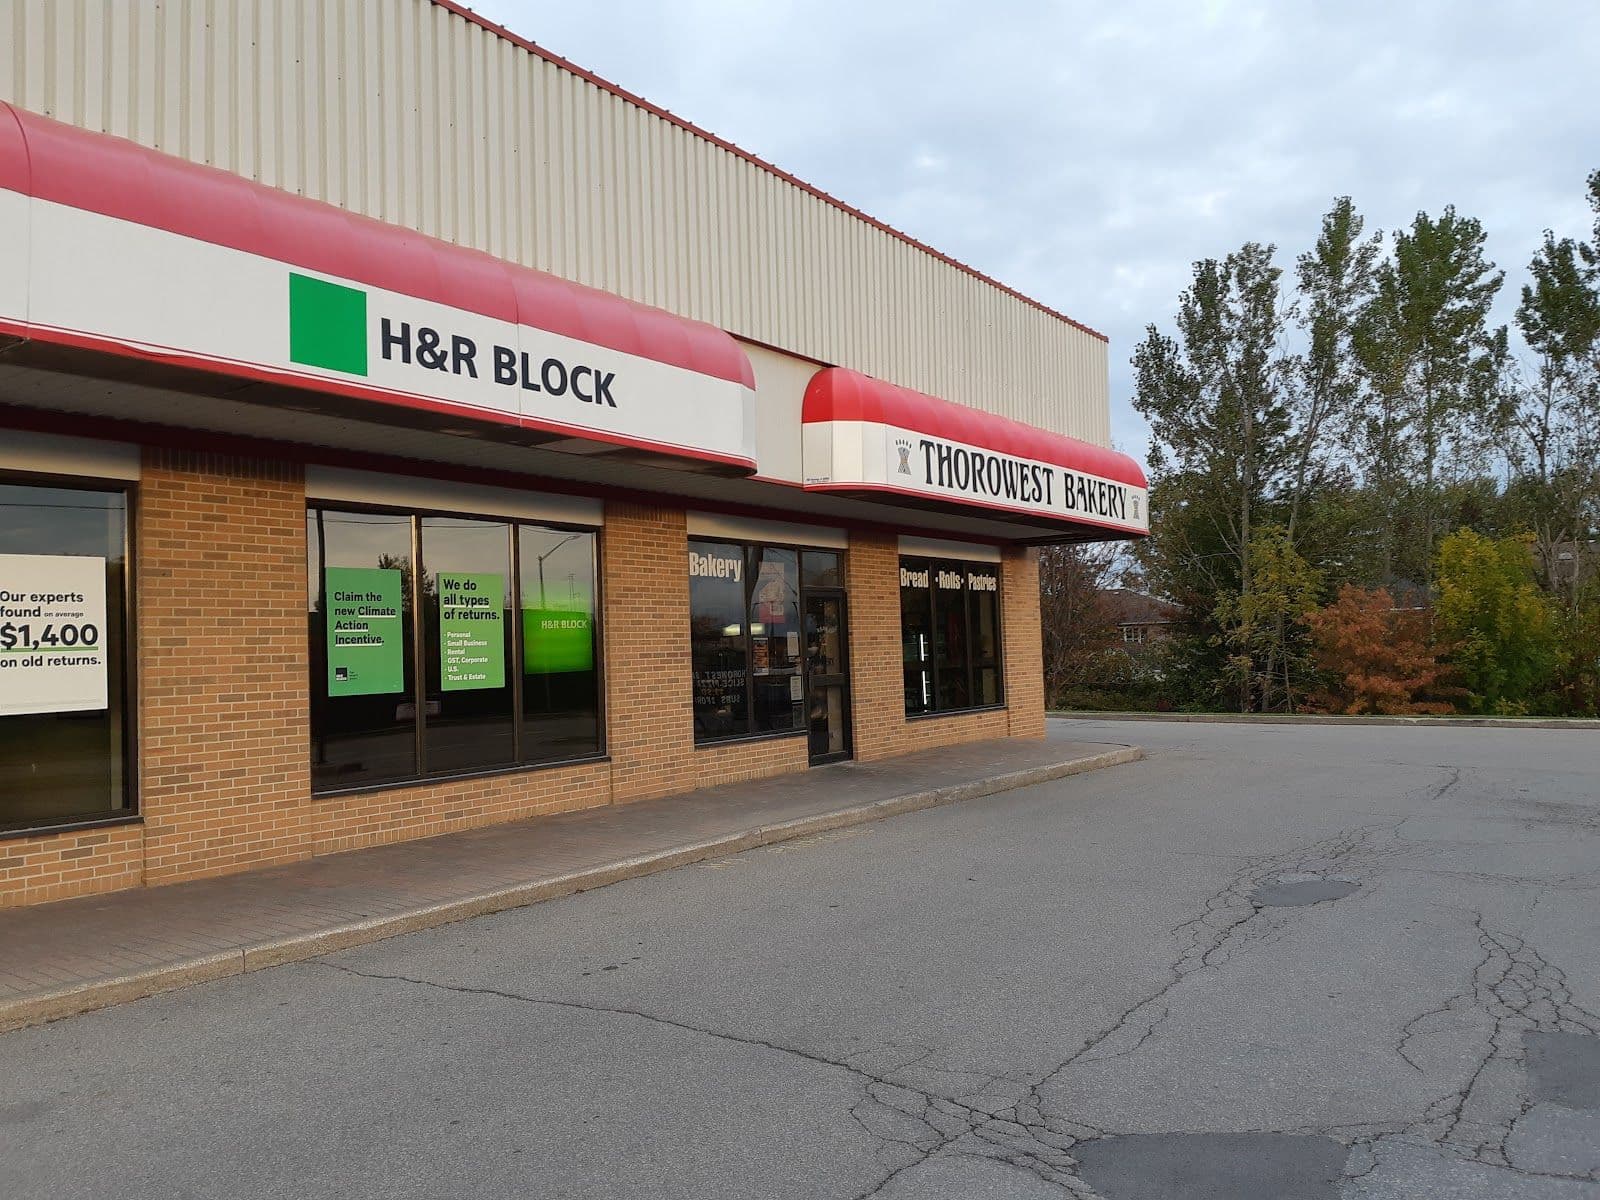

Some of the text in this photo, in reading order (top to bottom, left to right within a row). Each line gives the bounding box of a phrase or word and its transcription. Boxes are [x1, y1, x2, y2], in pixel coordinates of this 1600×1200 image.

[380, 317, 617, 408] H&R BLOCK
[919, 439, 1128, 520] THOROWEST BAKERY
[689, 552, 742, 582] Bakery
[443, 579, 477, 590] We do
[900, 567, 929, 588] Bread
[968, 573, 997, 591] Pastries
[0, 591, 84, 604] Our experts
[334, 592, 382, 602] Claim the
[443, 594, 490, 607] all types
[0, 606, 41, 618] found
[334, 606, 396, 616] new Climate
[443, 609, 500, 620] of returns.
[335, 620, 369, 630] Action
[541, 619, 588, 629] H&R BLOCK
[0, 622, 99, 650] $1,400
[335, 634, 385, 645] Incentive.
[0, 655, 102, 668] on old returns.
[461, 656, 489, 664] Corporate
